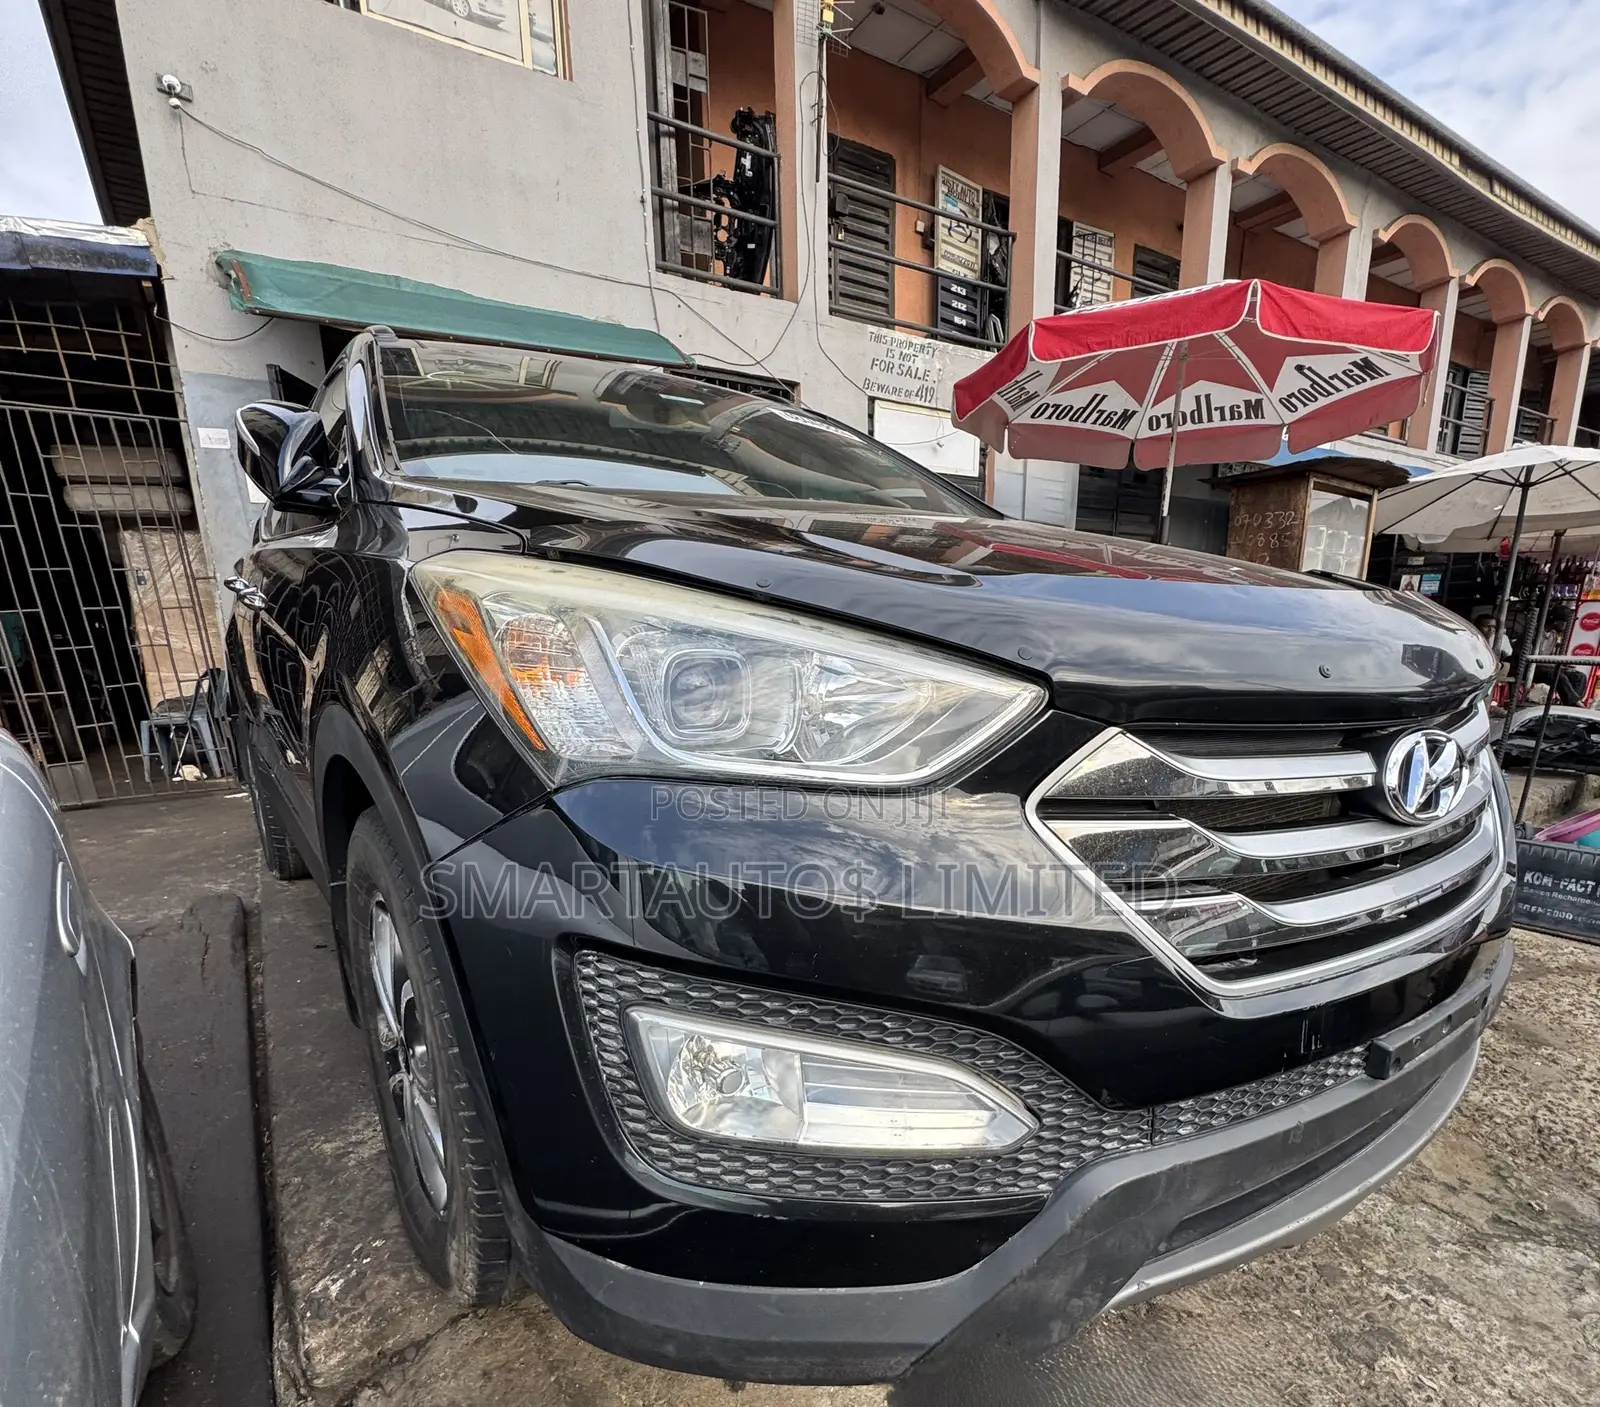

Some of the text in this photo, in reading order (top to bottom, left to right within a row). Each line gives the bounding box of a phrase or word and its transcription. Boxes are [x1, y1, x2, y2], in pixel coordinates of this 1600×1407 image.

[951, 299, 967, 311] 212
[869, 331, 938, 358] THIS PROPERTY
[885, 348, 919, 364] IS NOT
[870, 357, 895, 375] FOR
[862, 377, 936, 403] BEWARE OF 419
